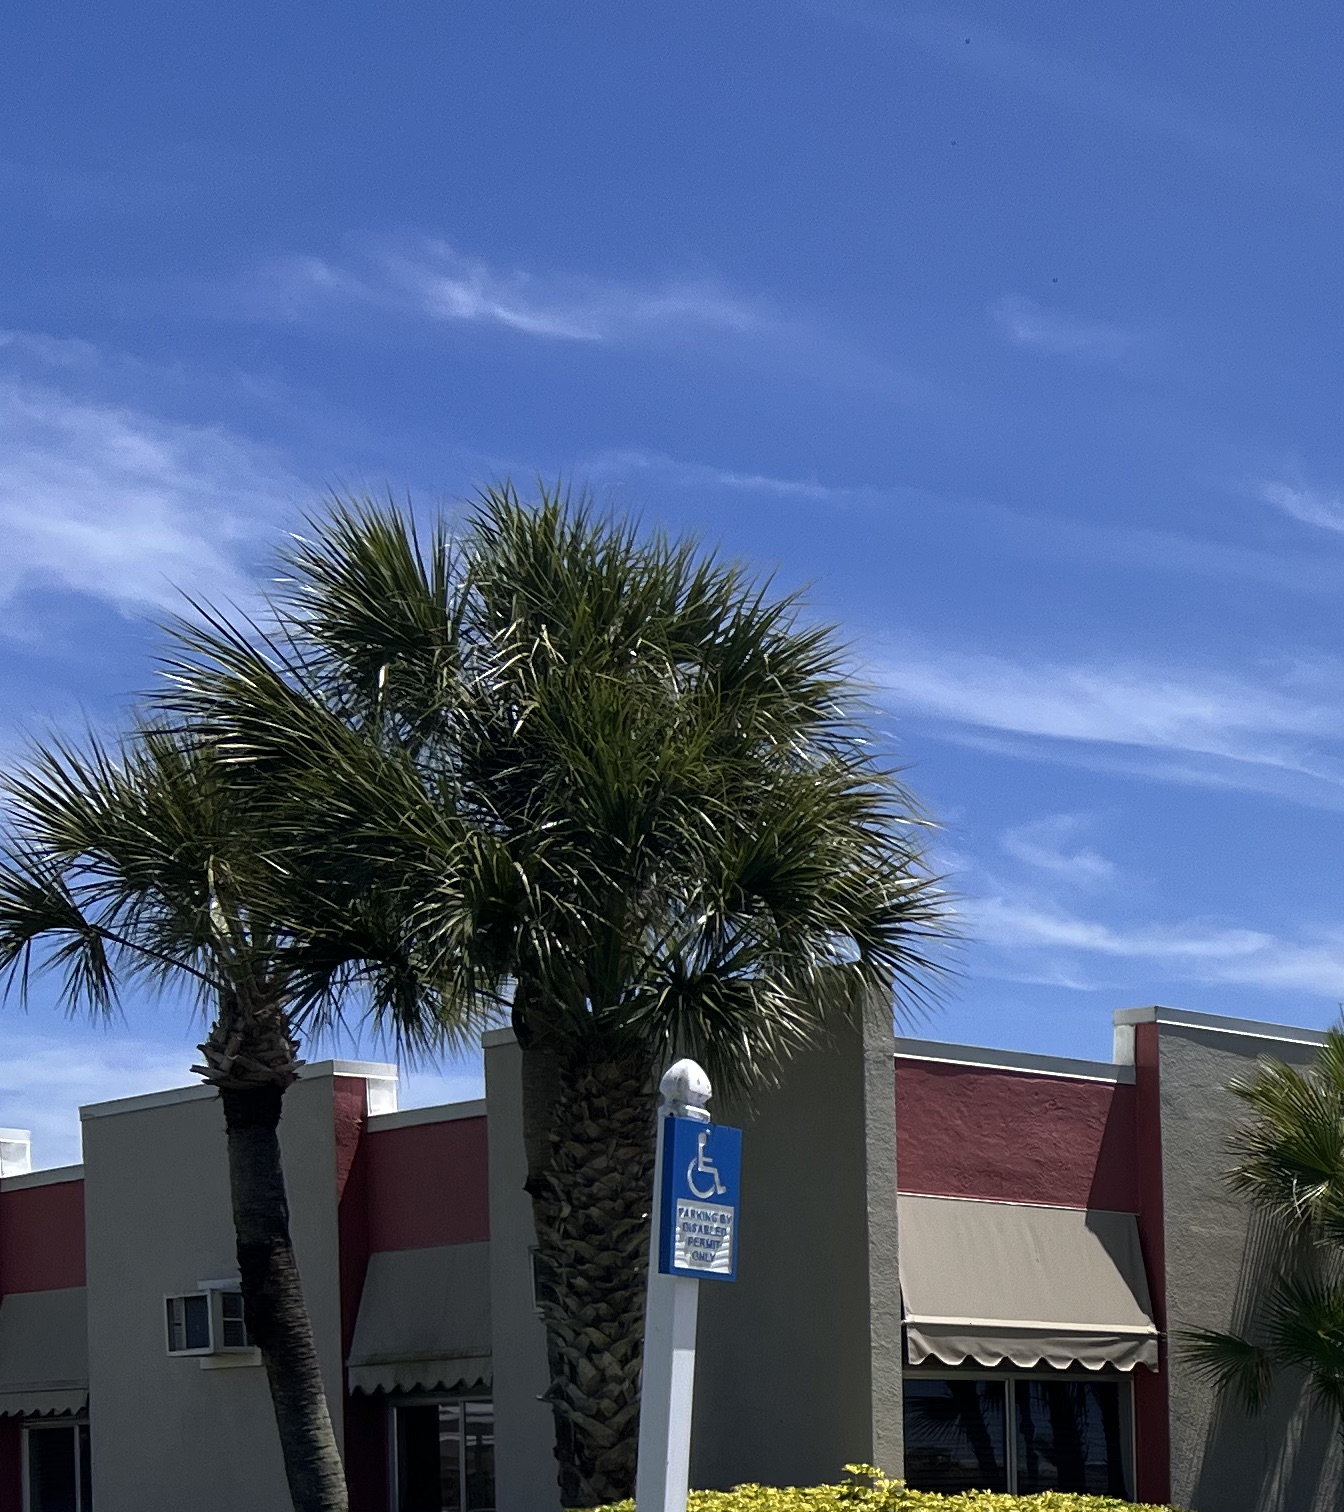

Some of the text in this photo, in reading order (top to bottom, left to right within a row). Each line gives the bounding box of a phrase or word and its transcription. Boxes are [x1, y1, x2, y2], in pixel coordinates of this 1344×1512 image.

[678, 1208, 732, 1224] PARKING BY
[682, 1222, 727, 1236] DISABLED
[688, 1236, 721, 1249] PERMIT
[691, 1250, 716, 1262] ONLY
